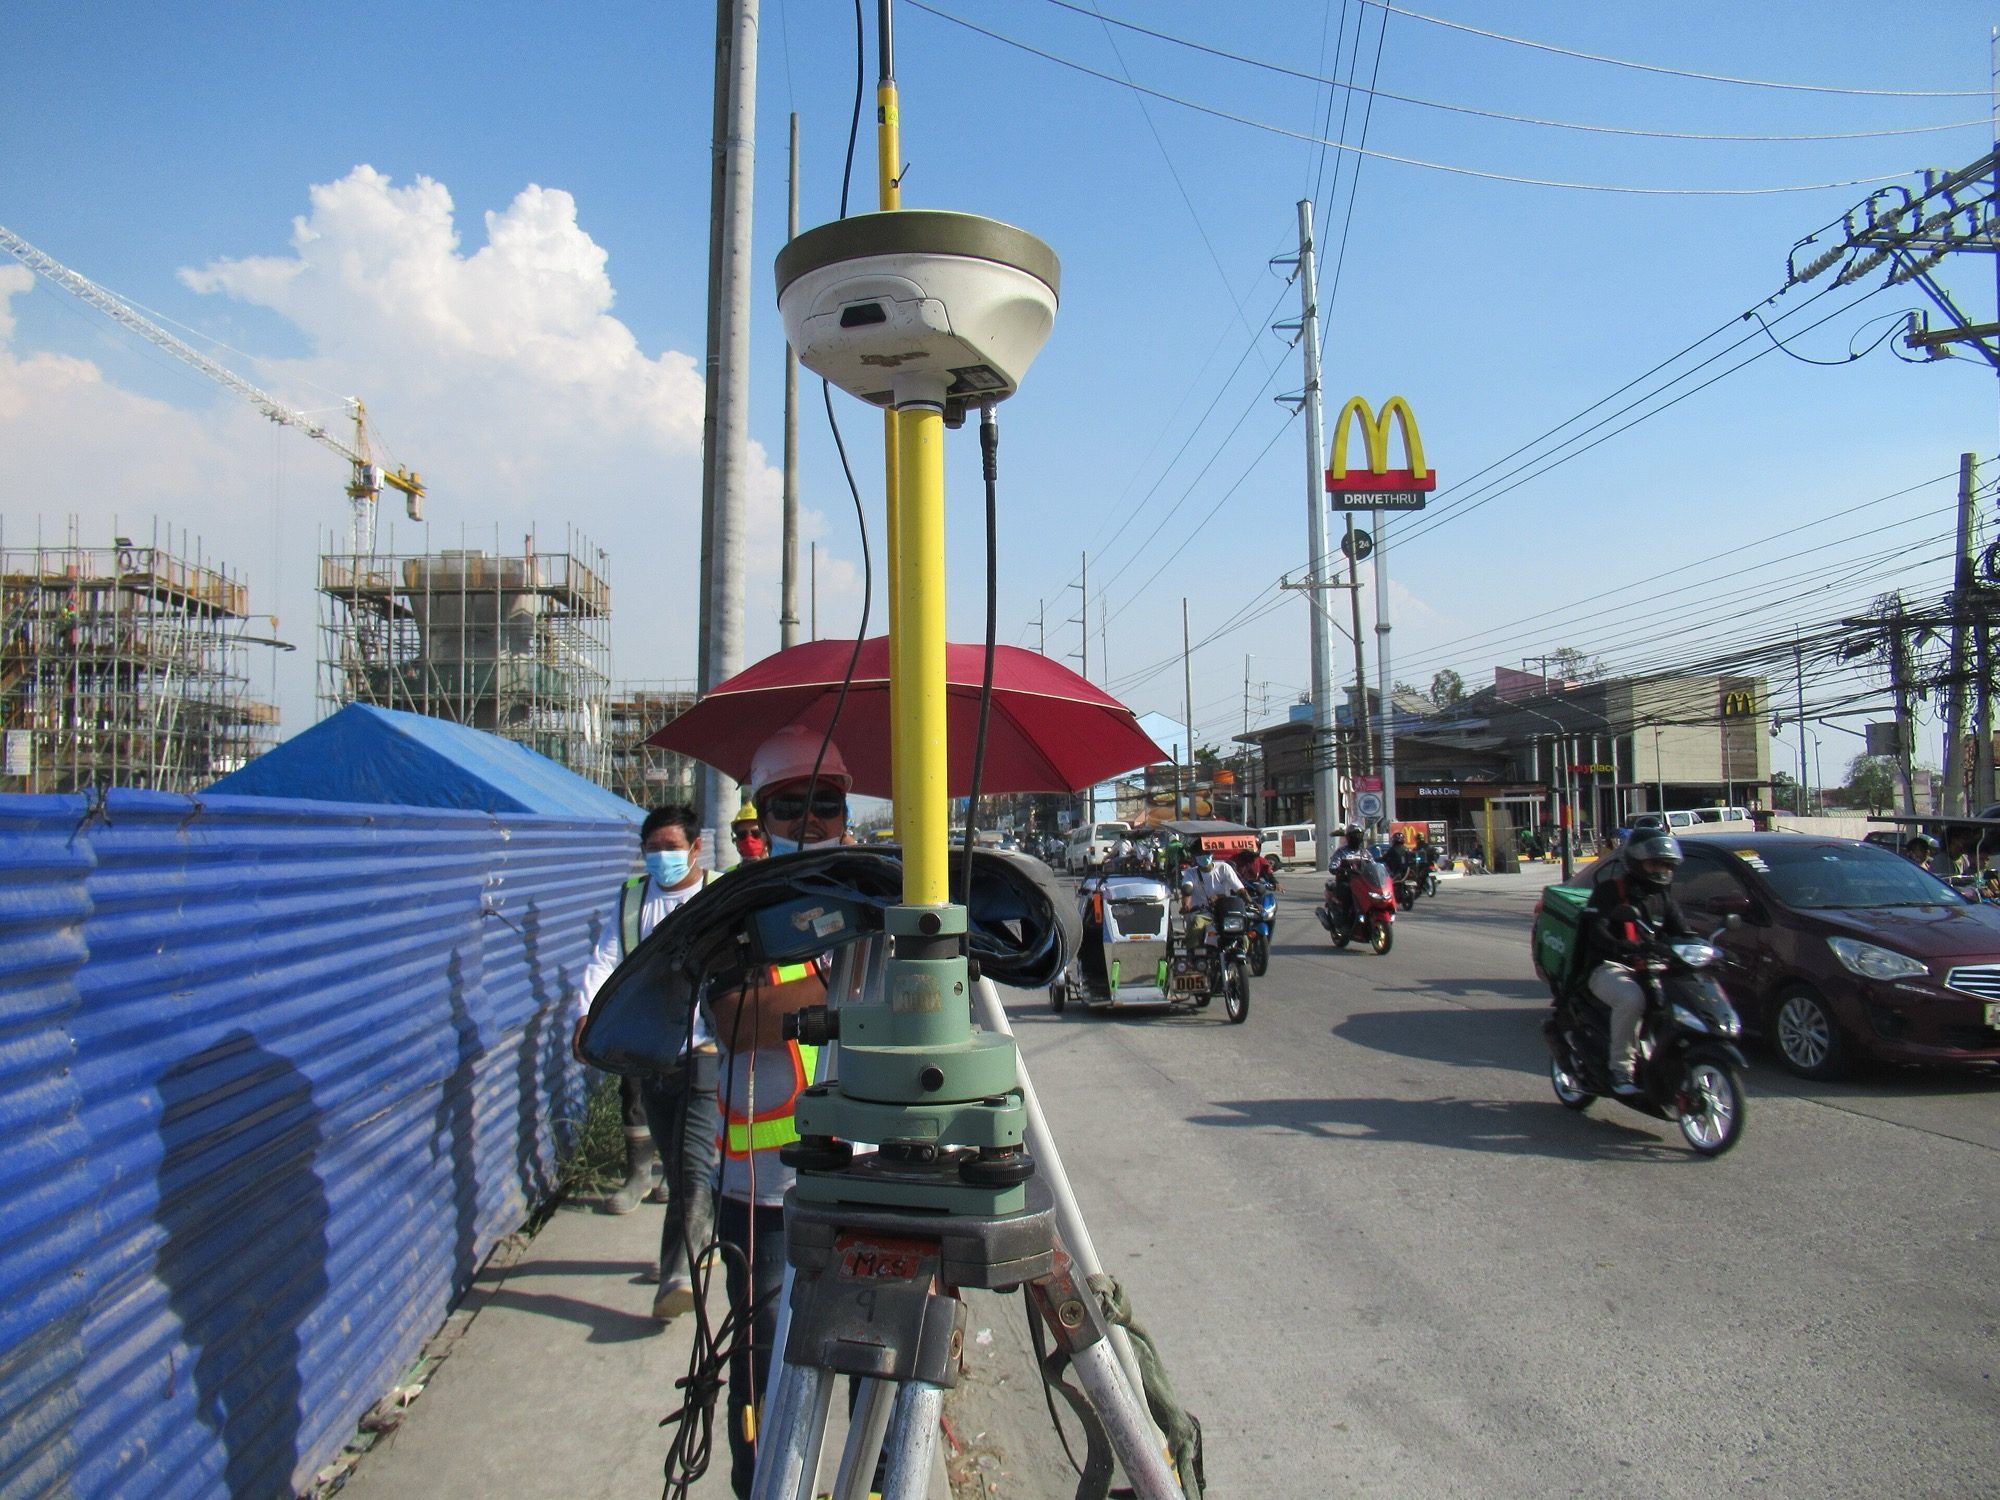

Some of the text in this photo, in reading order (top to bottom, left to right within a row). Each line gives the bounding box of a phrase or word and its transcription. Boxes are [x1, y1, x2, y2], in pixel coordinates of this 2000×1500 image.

[1343, 494, 1417, 505] DRIVETHRU
[1436, 835, 1446, 843] 24
[1203, 840, 1254, 850] SAN LUIS
